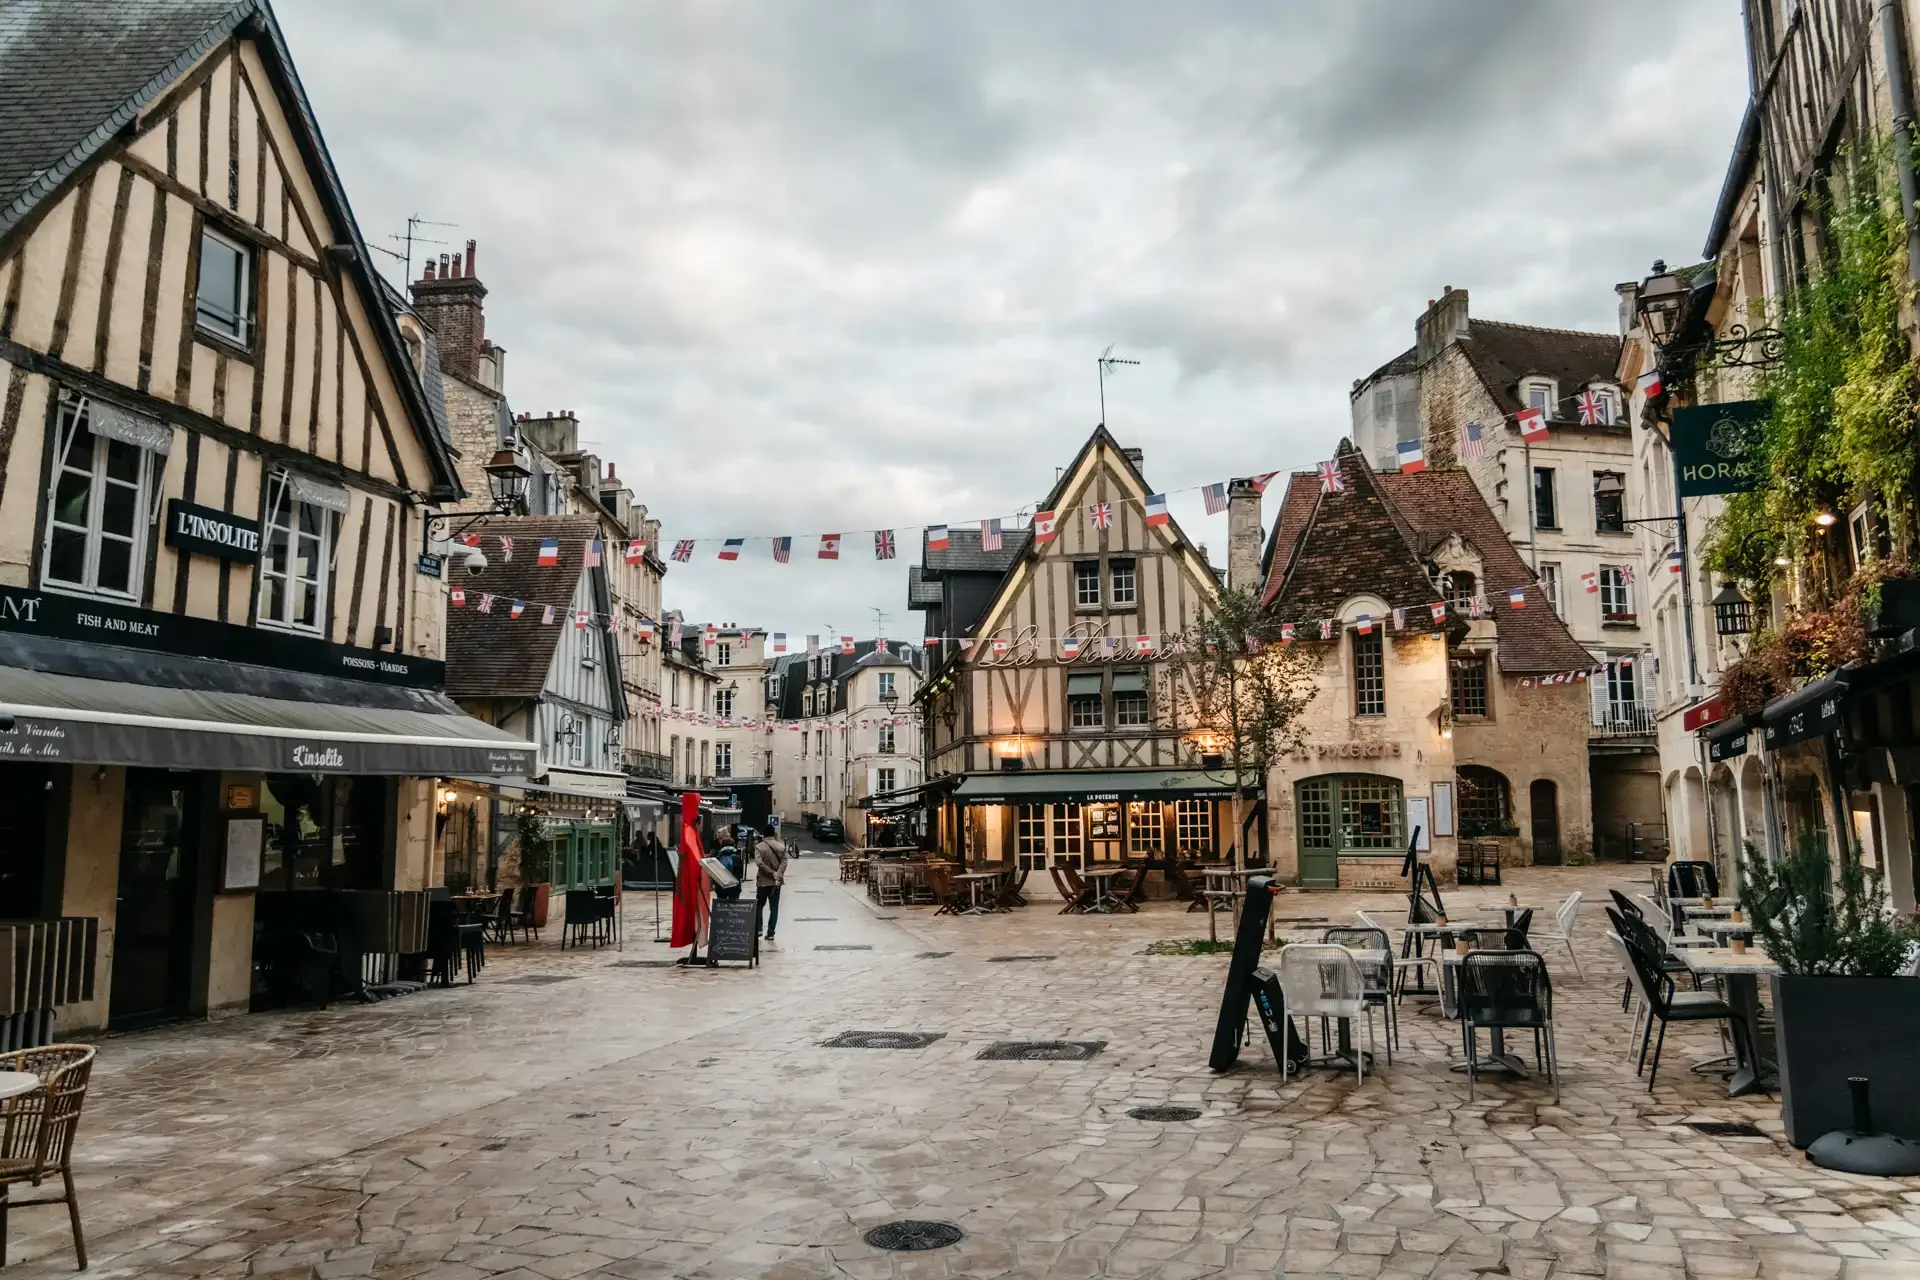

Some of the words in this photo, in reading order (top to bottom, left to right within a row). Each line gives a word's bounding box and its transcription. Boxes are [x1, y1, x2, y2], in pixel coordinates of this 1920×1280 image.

[177, 512, 260, 552] L'INSOLITE
[77, 613, 101, 628] FISH
[104, 617, 127, 632] AND
[129, 621, 160, 637] MEAT
[342, 656, 376, 670] POISSONS
[380, 661, 409, 675] VIANDES
[25, 723, 65, 738] Viandes
[20, 743, 32, 755] de
[293, 745, 344, 767] L'insolite
